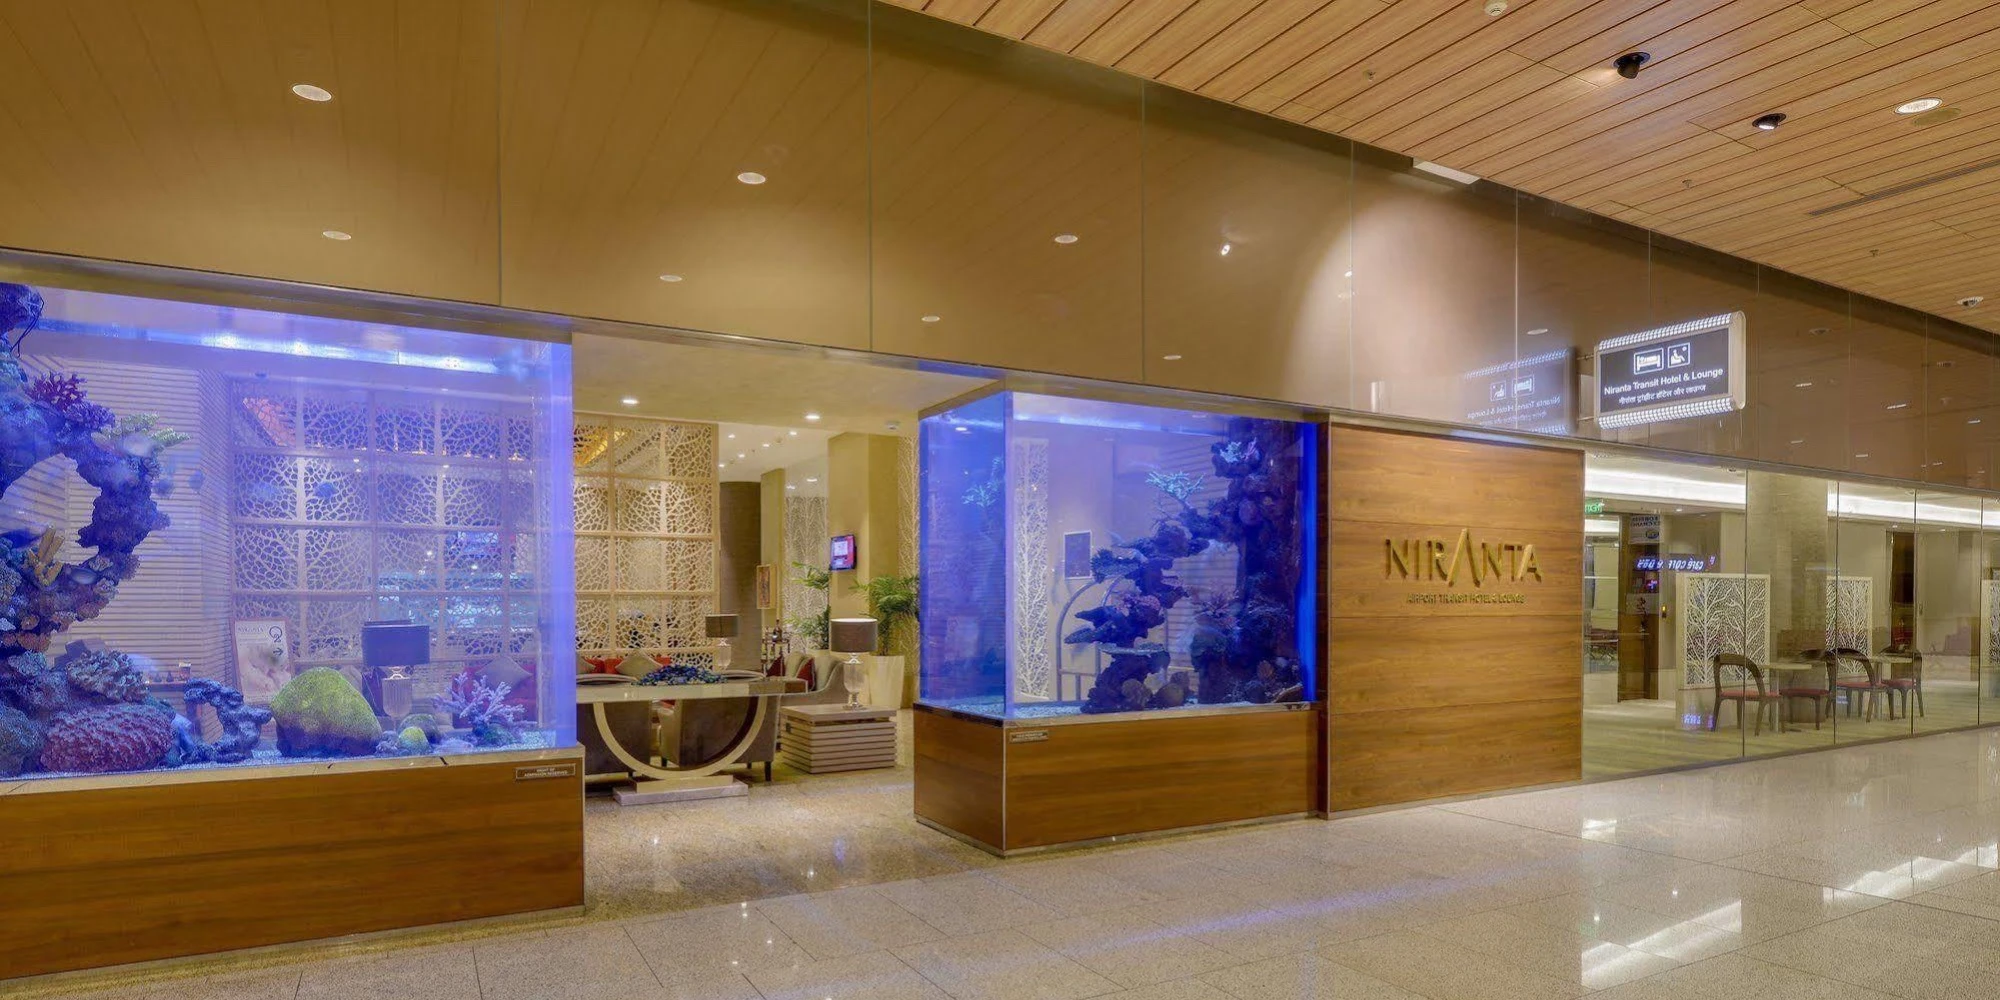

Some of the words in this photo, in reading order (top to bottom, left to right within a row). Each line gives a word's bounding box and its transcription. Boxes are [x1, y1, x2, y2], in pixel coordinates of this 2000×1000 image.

[1604, 384, 1631, 395] Niranta
[1633, 378, 1659, 390] Transit
[1661, 374, 1681, 385] Hotel
[1683, 373, 1690, 381] &
[1692, 368, 1723, 380] Lounge
[1385, 528, 1543, 587] NIRANTA
[1407, 592, 1437, 604] AIRPORT
[1439, 593, 1468, 604] TRANSIT
[1470, 594, 1490, 604] HOTEL
[1498, 594, 1525, 604] LOUNGE
